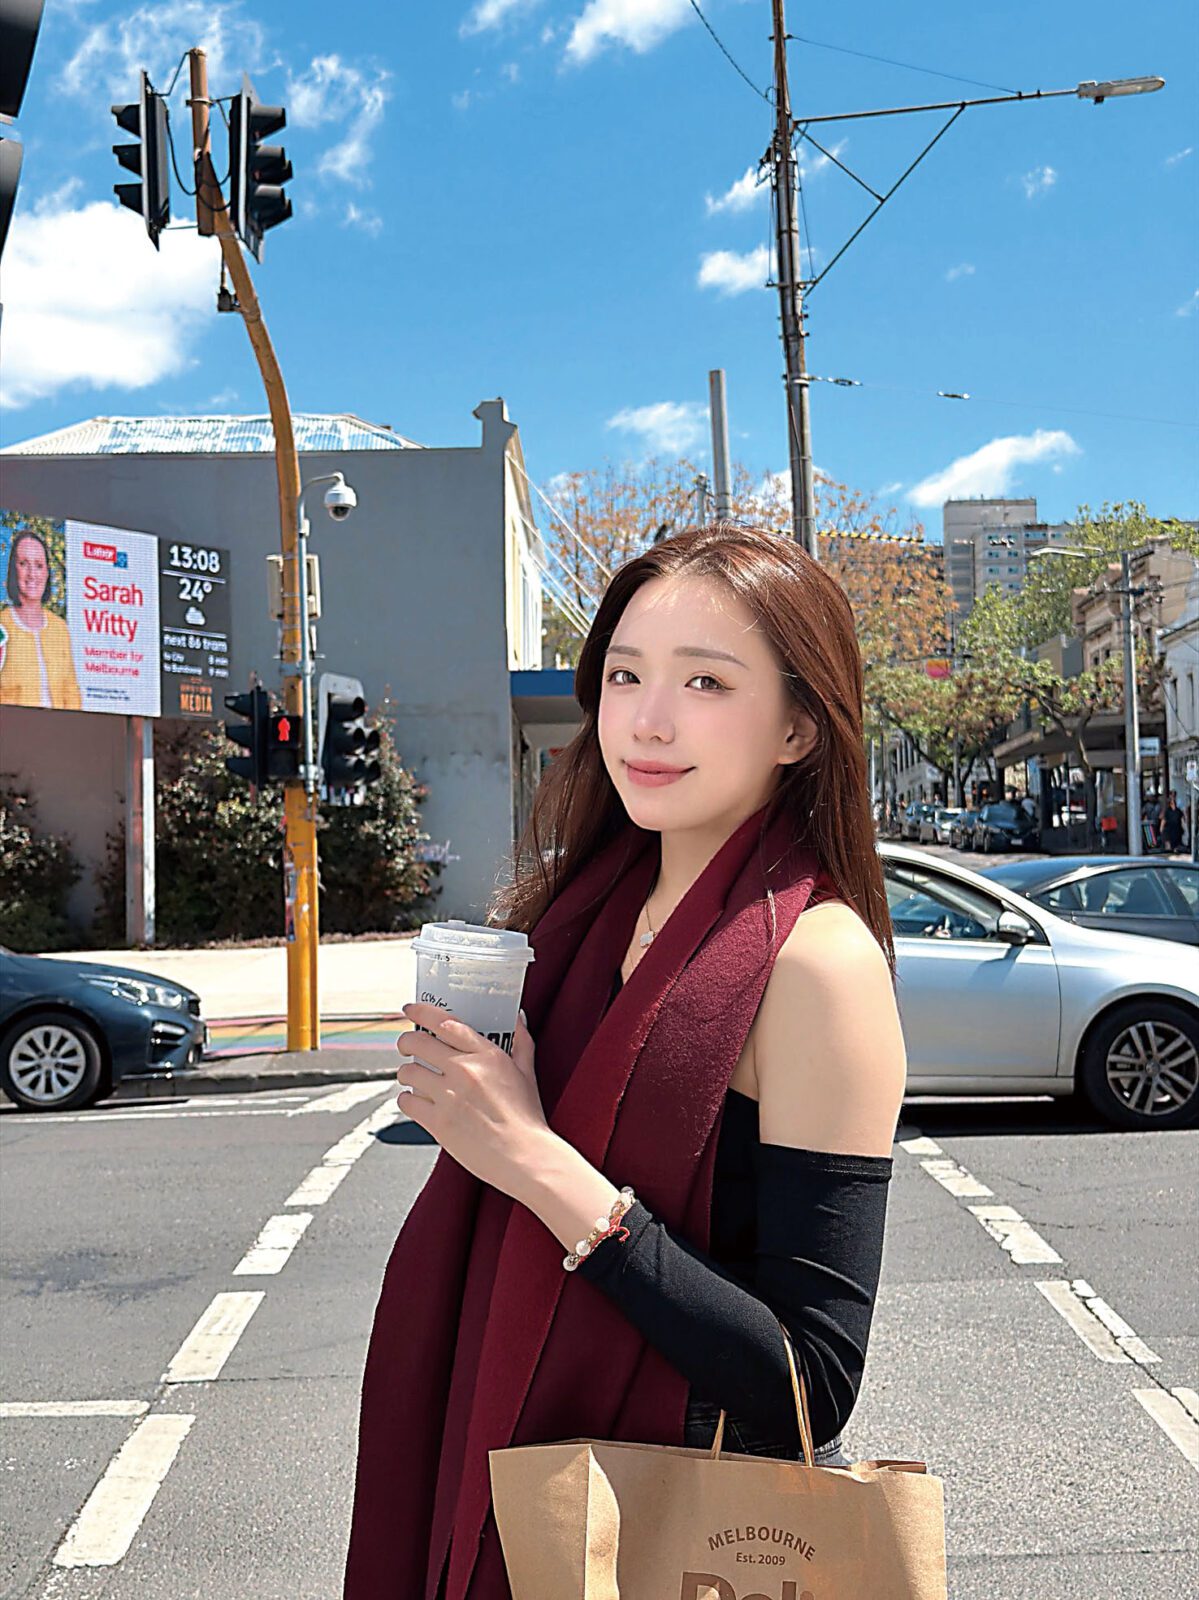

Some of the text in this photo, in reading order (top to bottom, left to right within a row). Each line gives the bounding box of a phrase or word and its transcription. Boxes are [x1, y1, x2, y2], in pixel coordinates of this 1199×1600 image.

[169, 545, 220, 573] 13:08
[84, 576, 143, 607] Sarah
[84, 609, 138, 642] Witty
[180, 693, 212, 712] MEDIA
[707, 1525, 816, 1562] MELBOURNE
[736, 1552, 786, 1566] Est. 2009
